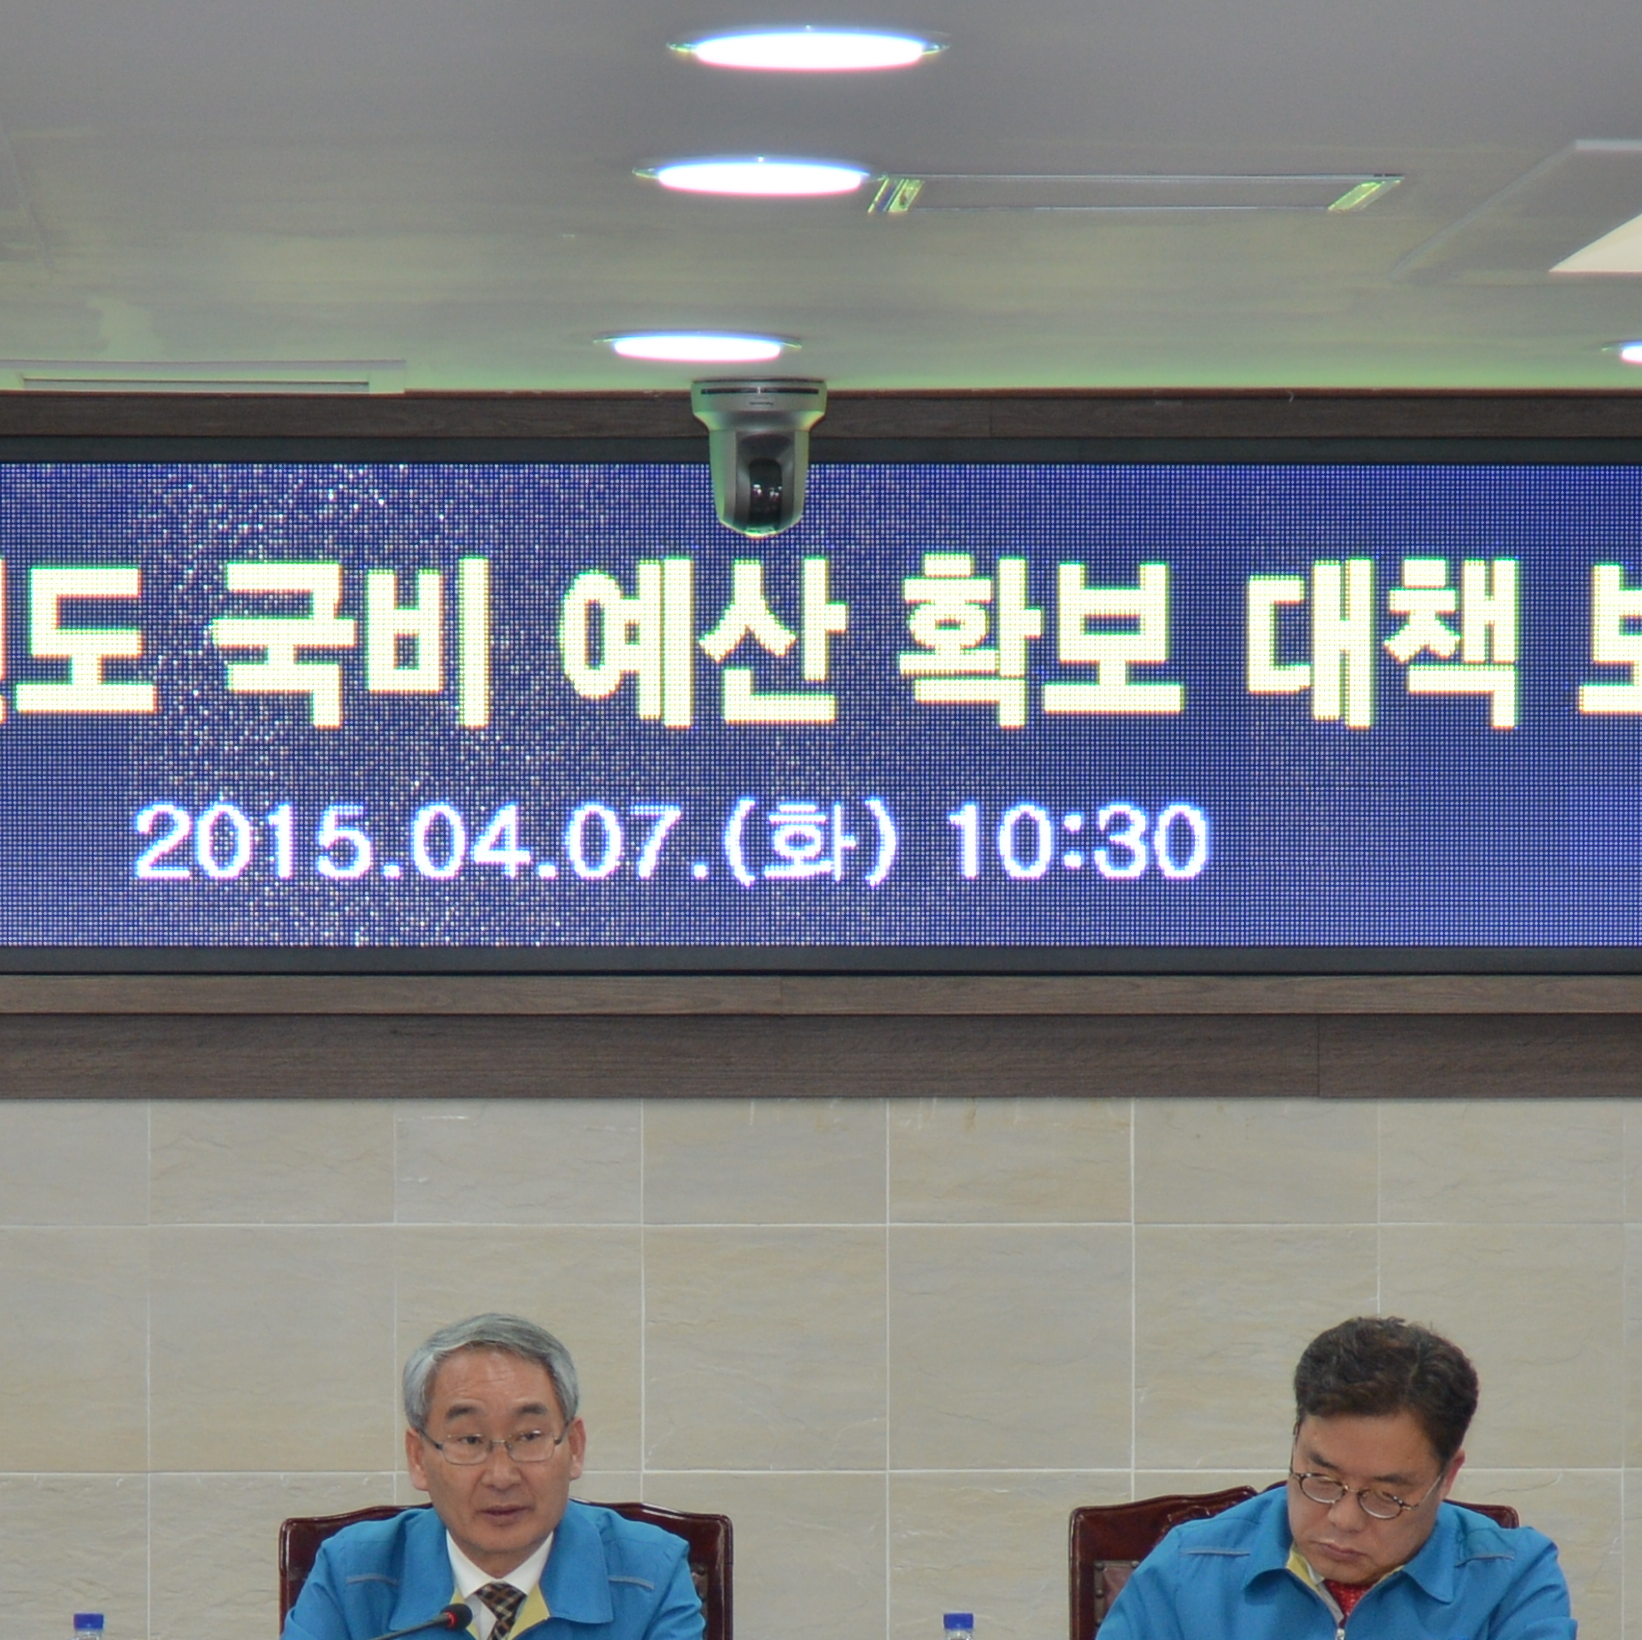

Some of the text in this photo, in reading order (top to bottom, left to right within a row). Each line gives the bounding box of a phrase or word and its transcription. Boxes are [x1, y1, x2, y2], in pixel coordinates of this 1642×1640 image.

[207, 558, 492, 730] 국비
[557, 556, 851, 729] 예산
[897, 553, 1184, 729] 확보
[1245, 558, 1519, 730] 대책
[133, 797, 1211, 888] 2015.04.07.(화) 10:30
